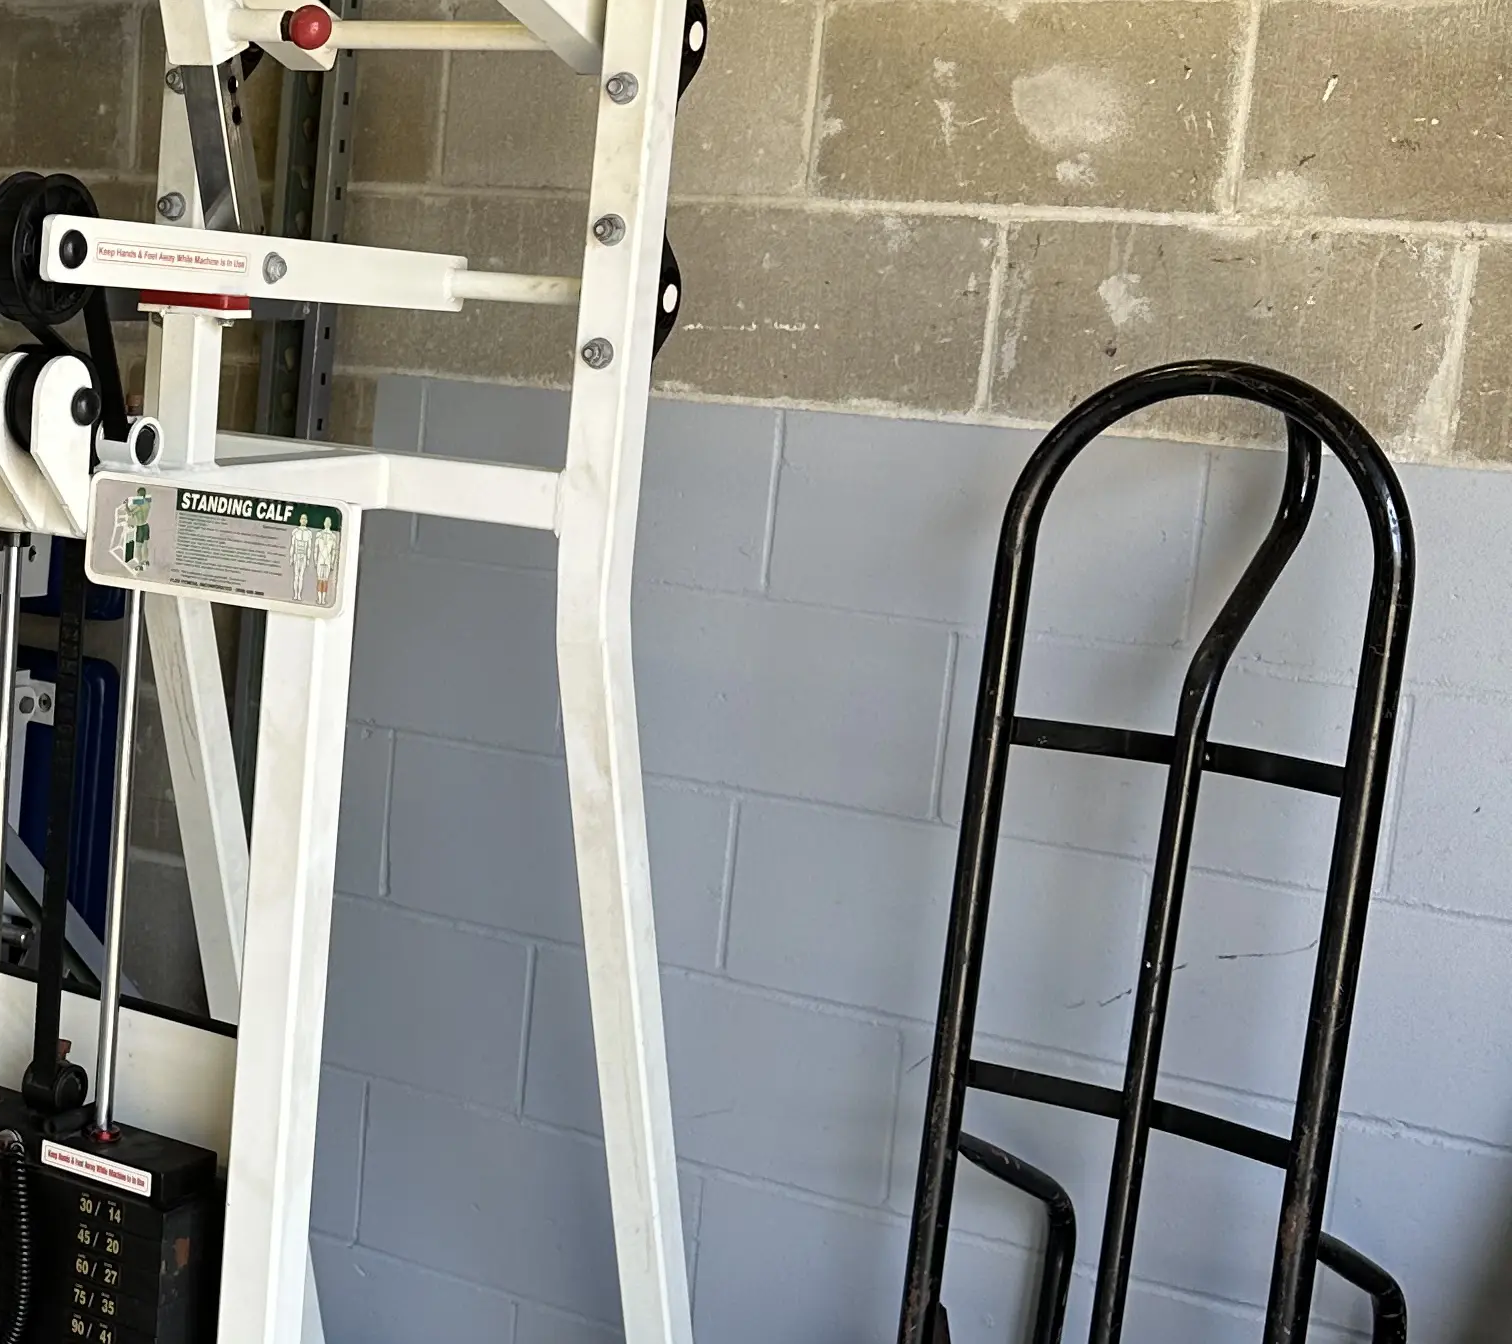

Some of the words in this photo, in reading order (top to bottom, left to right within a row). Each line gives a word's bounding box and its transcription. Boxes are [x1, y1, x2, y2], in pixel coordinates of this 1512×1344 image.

[99, 247, 115, 258] Keep
[117, 249, 136, 258] Hands
[138, 250, 142, 258] &
[144, 251, 157, 260] Feet
[159, 252, 175, 263] Away
[177, 254, 193, 264] While
[194, 256, 219, 266] Machine
[234, 259, 244, 269] Use
[181, 492, 253, 517] STANDING
[256, 502, 294, 522] CALF
[79, 1197, 93, 1214] 30
[108, 1206, 121, 1224] 14
[77, 1228, 90, 1245] 45
[106, 1238, 119, 1254] 20
[76, 1258, 89, 1275] 60
[104, 1268, 117, 1285] 27
[73, 1287, 86, 1305] 75
[101, 1298, 115, 1315] 35
[71, 1318, 84, 1335] 90
